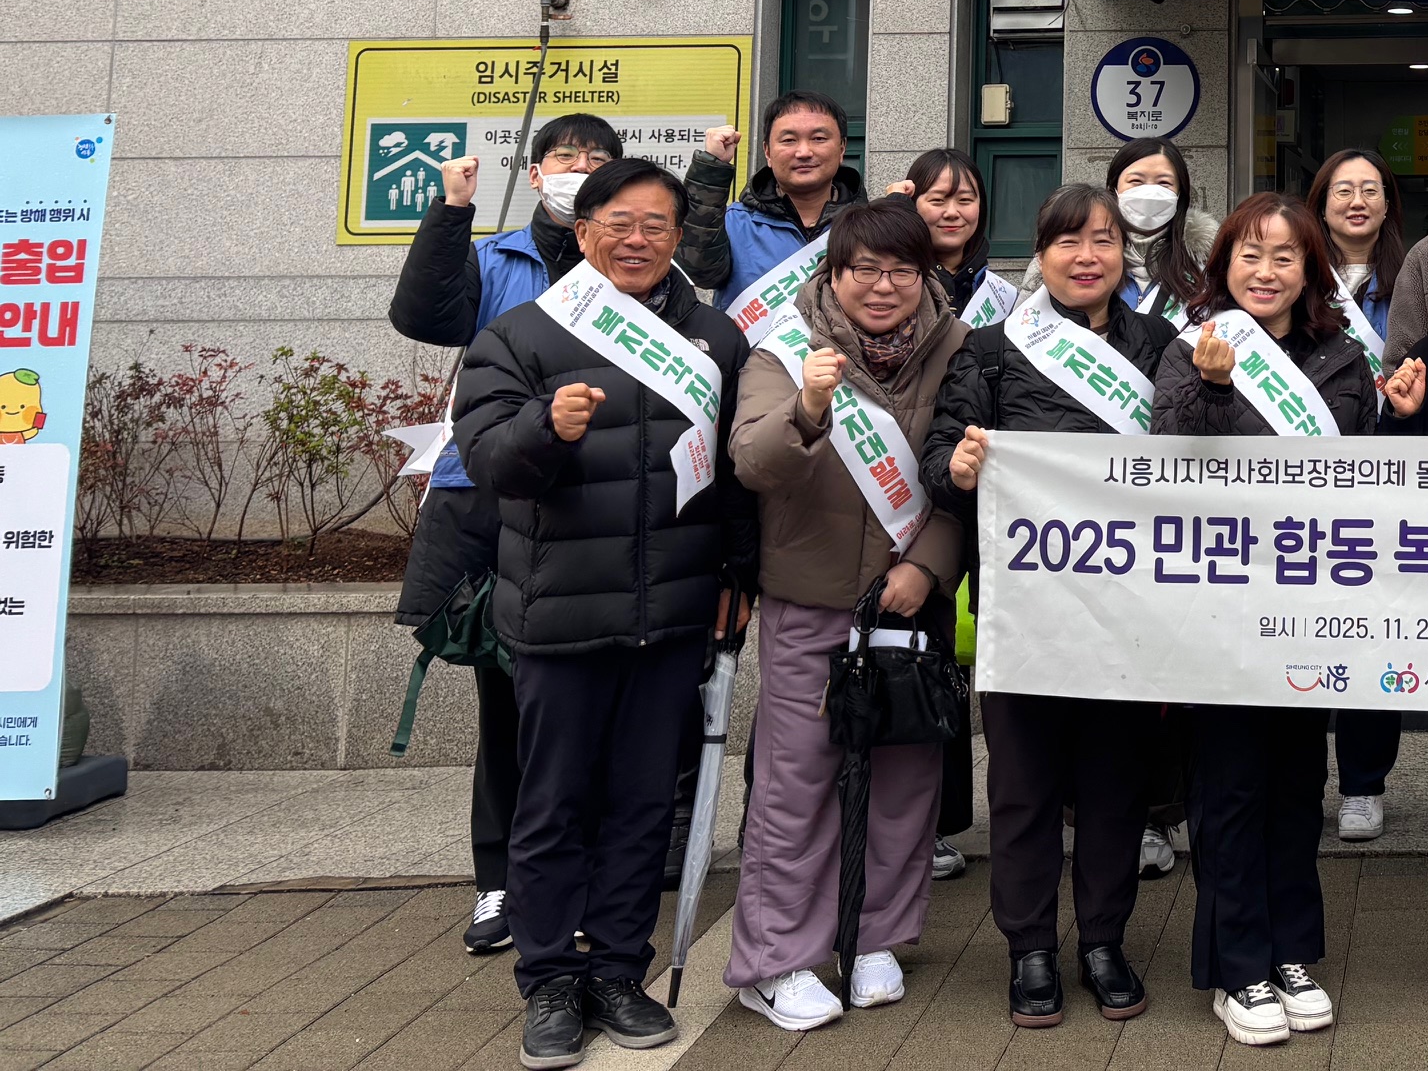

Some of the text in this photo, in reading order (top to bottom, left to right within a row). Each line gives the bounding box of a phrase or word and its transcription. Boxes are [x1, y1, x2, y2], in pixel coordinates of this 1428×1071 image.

[474, 57, 621, 86] 임시주거시설
[471, 89, 621, 107] (DISASTR SHELTER)
[1125, 80, 1166, 108] 37
[1126, 110, 1163, 122] 복지로
[648, 128, 706, 143] 사용되는
[20, 208, 46, 223] 방해
[49, 207, 76, 223] 행위
[77, 207, 91, 222] 시
[0, 238, 88, 286] 출입
[0, 301, 80, 348] 안내
[592, 305, 720, 424] 복지사각지대
[868, 455, 914, 511] 발굴
[1103, 455, 1407, 489] 시흥시지역사회보장협의체
[2, 529, 54, 550] 위험한
[1006, 517, 1137, 576] 2025
[1153, 515, 1259, 585] 민관
[1272, 516, 1379, 587] 합동
[1259, 616, 1296, 638] 일시
[1314, 616, 1375, 640] 2025.
[1383, 617, 1409, 641] 11.
